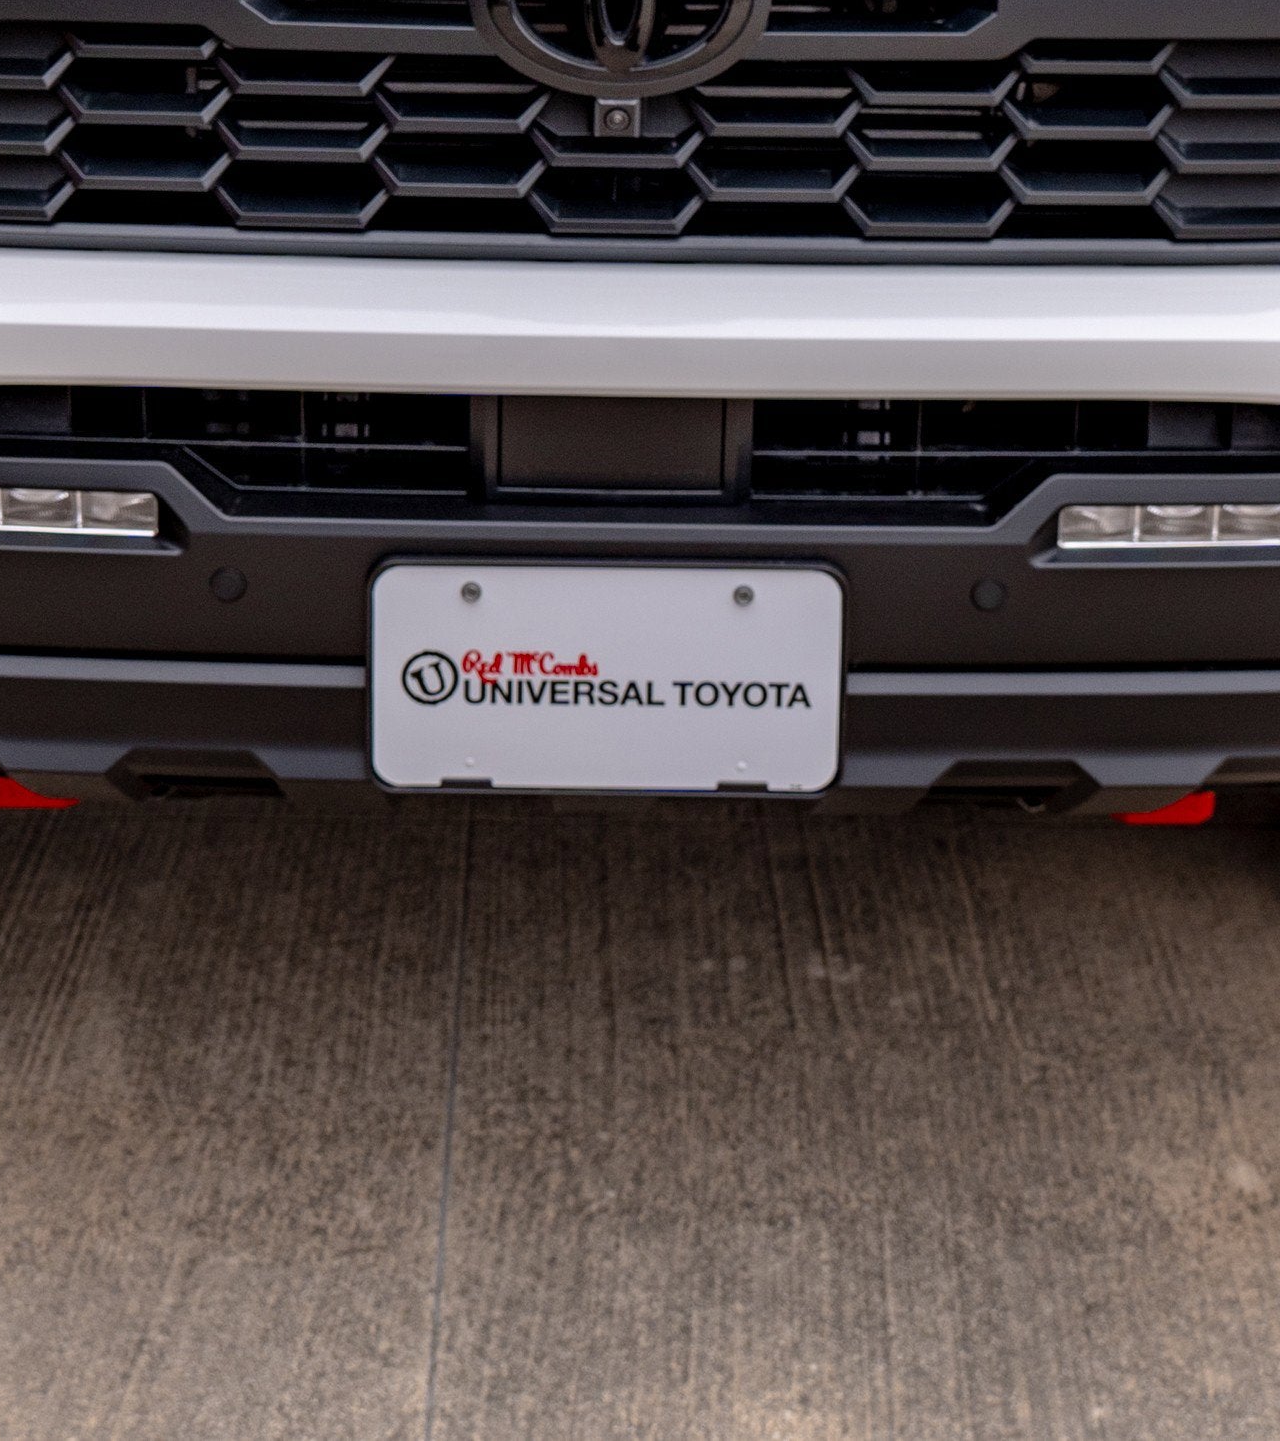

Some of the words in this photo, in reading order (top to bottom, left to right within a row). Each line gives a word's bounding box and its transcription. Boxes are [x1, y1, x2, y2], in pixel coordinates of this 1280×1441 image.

[462, 650, 503, 685] Red
[507, 651, 599, 677] McCombs
[464, 678, 665, 707] UNIVERSAL
[673, 681, 811, 708] TOYOTA
